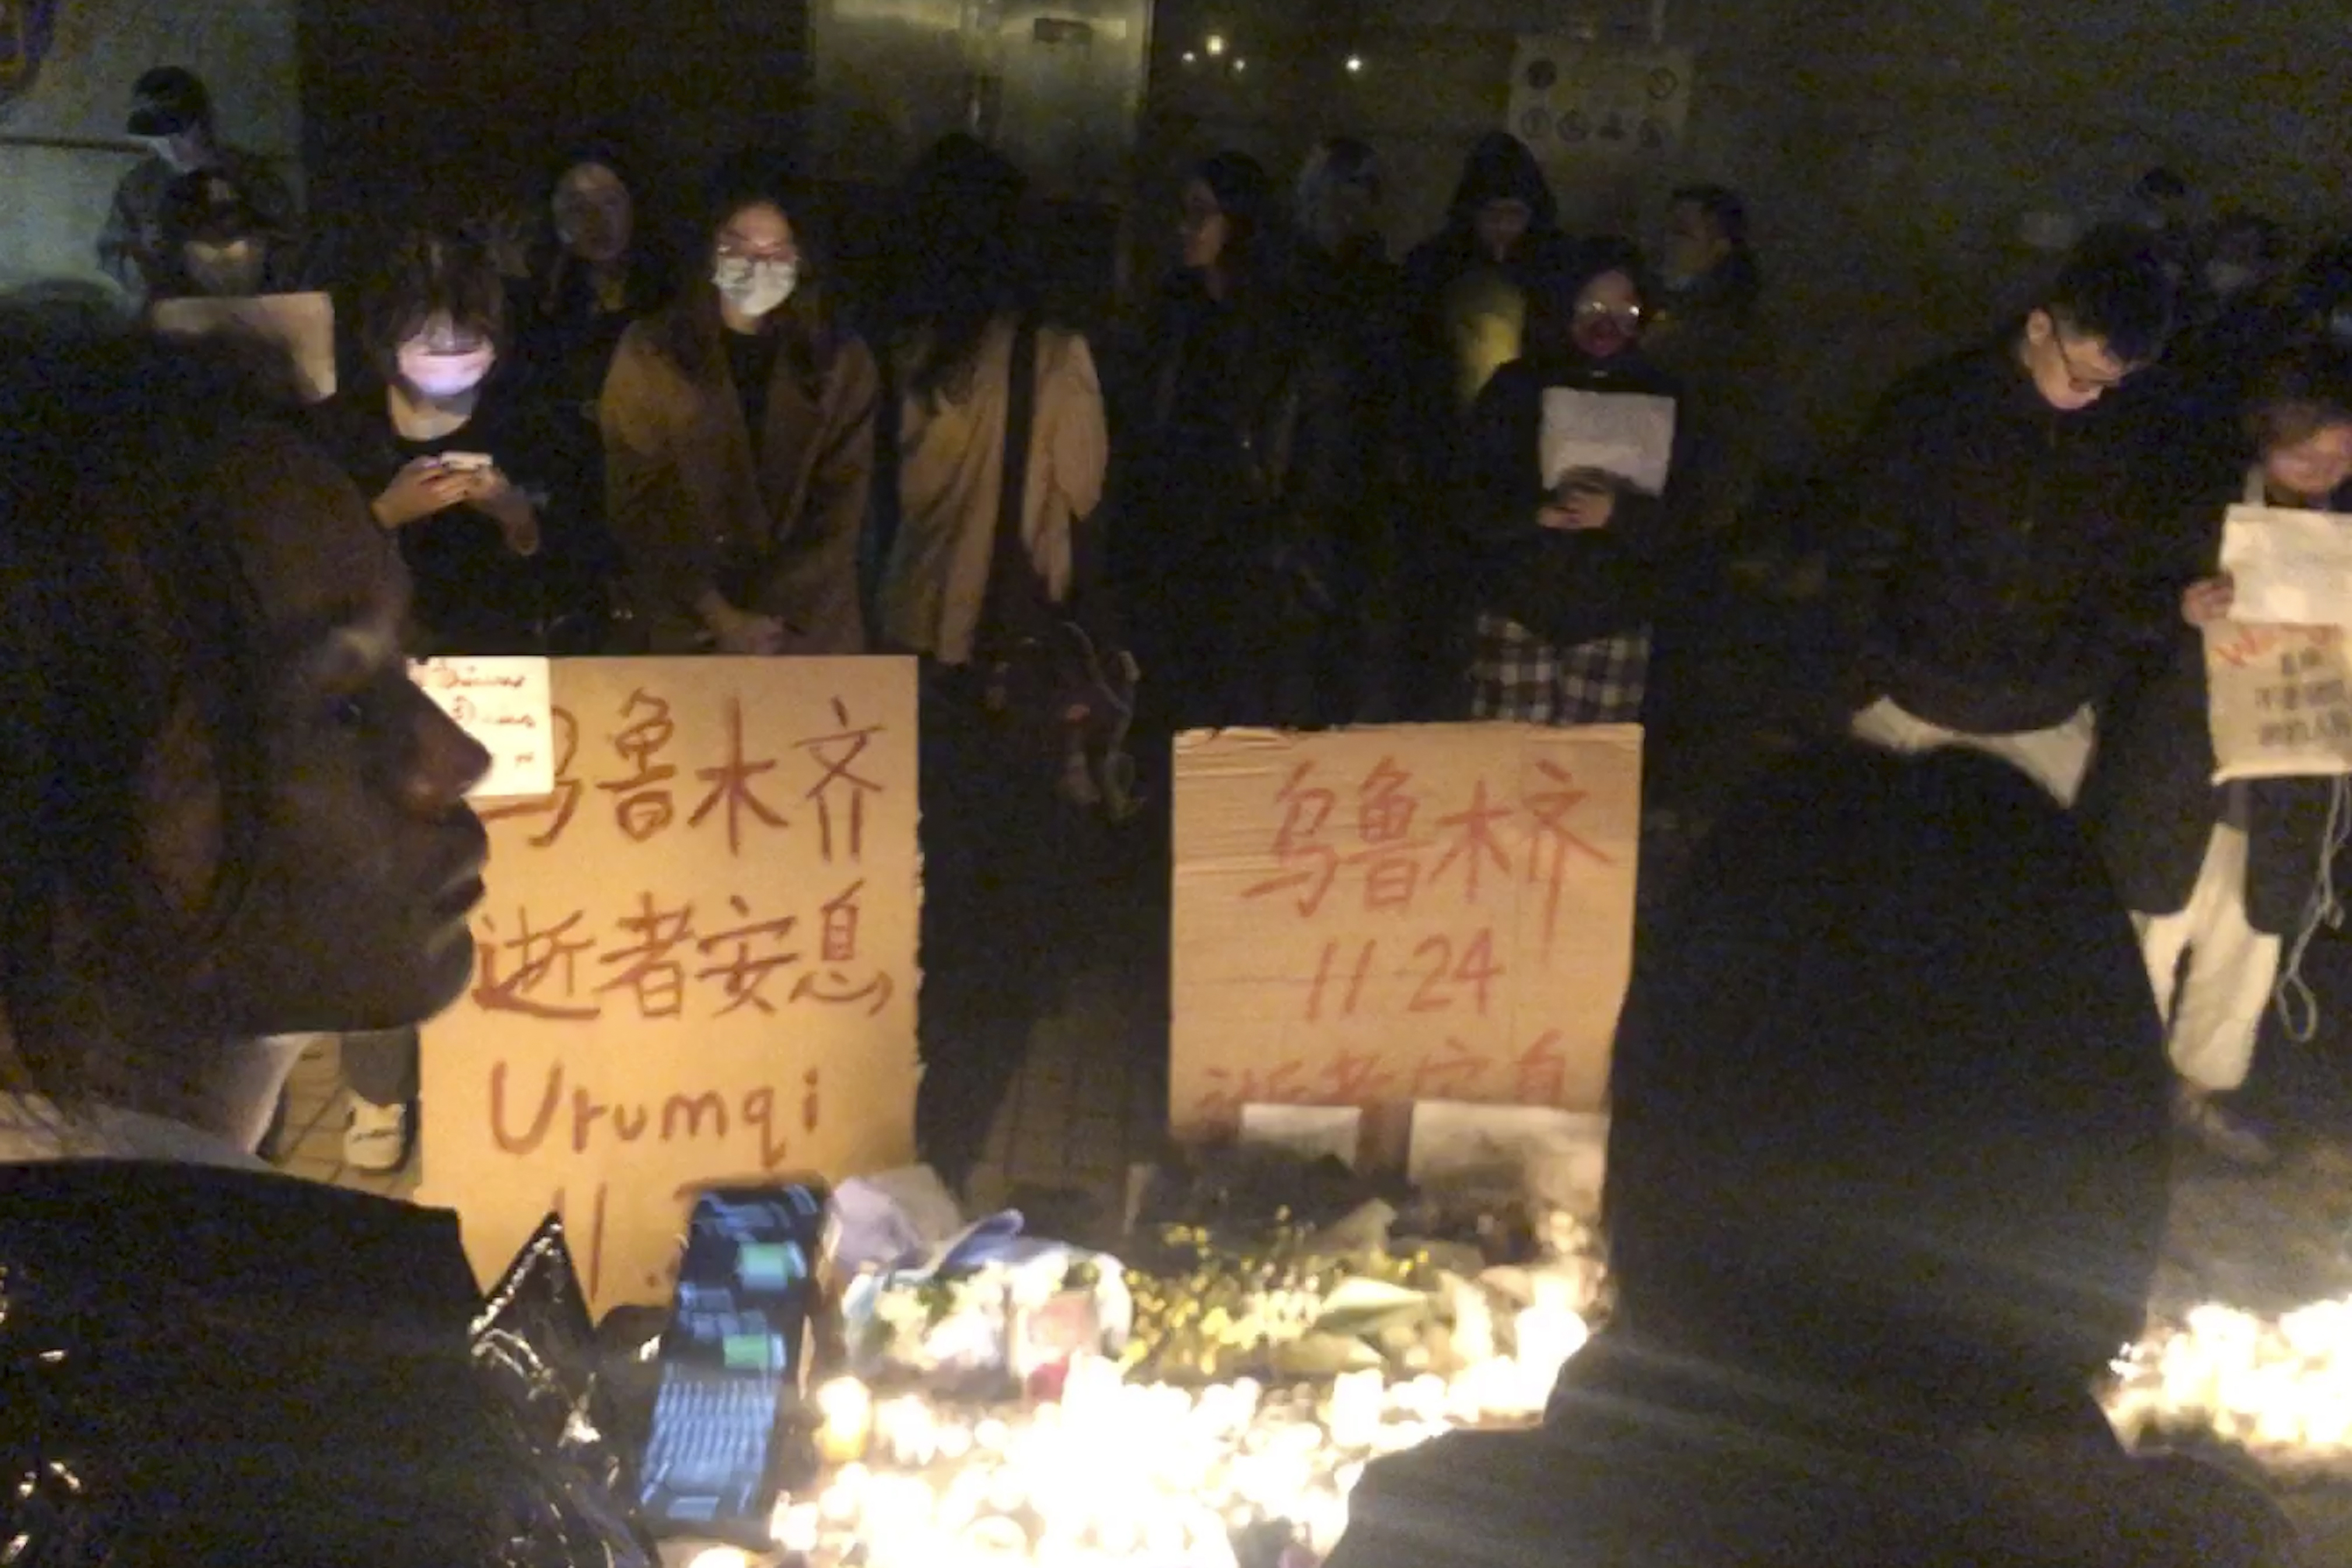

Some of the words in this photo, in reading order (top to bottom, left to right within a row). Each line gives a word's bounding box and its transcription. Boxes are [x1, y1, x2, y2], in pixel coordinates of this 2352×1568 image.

[1240, 754, 1615, 963] 乌鲁木齐
[471, 878, 895, 1021] 逝者安息
[490, 1059, 820, 1167] Urumqi
